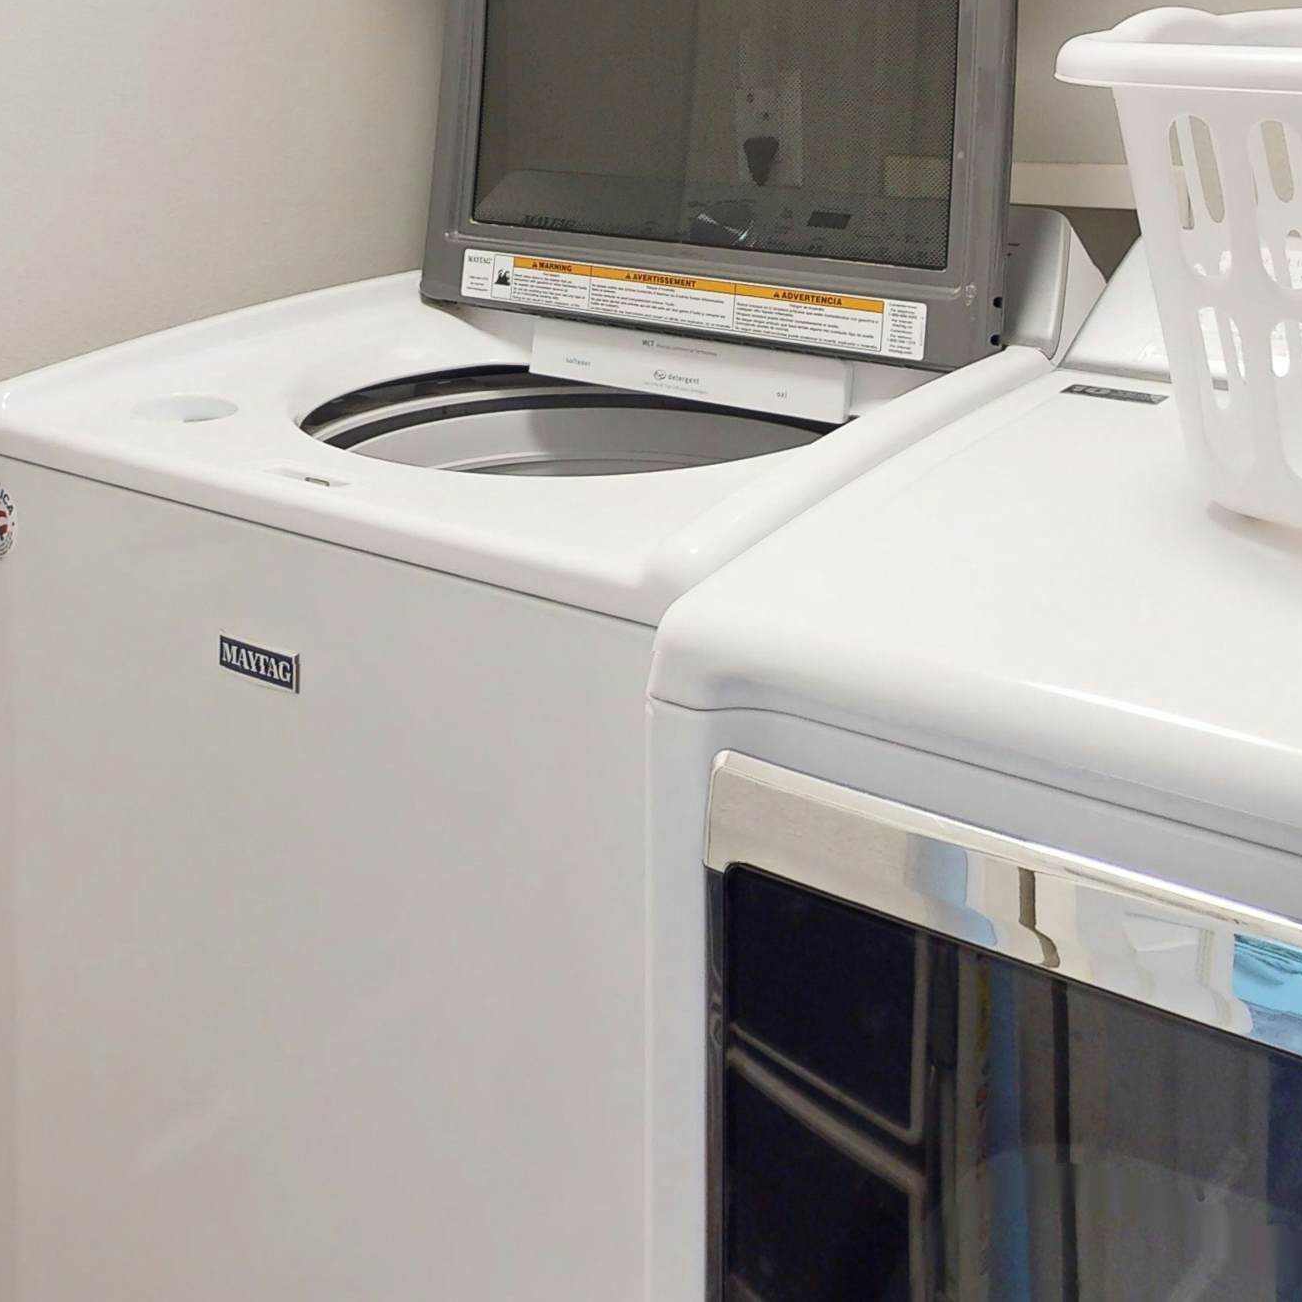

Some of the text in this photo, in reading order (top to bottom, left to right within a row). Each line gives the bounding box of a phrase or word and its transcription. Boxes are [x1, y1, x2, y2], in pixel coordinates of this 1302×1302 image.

[538, 261, 573, 273] WARNING
[632, 272, 697, 288] AVERTISSEMENT
[781, 291, 843, 306] ADVERTENCIA
[668, 374, 700, 385] detergent
[221, 641, 292, 683] MAYTAG
